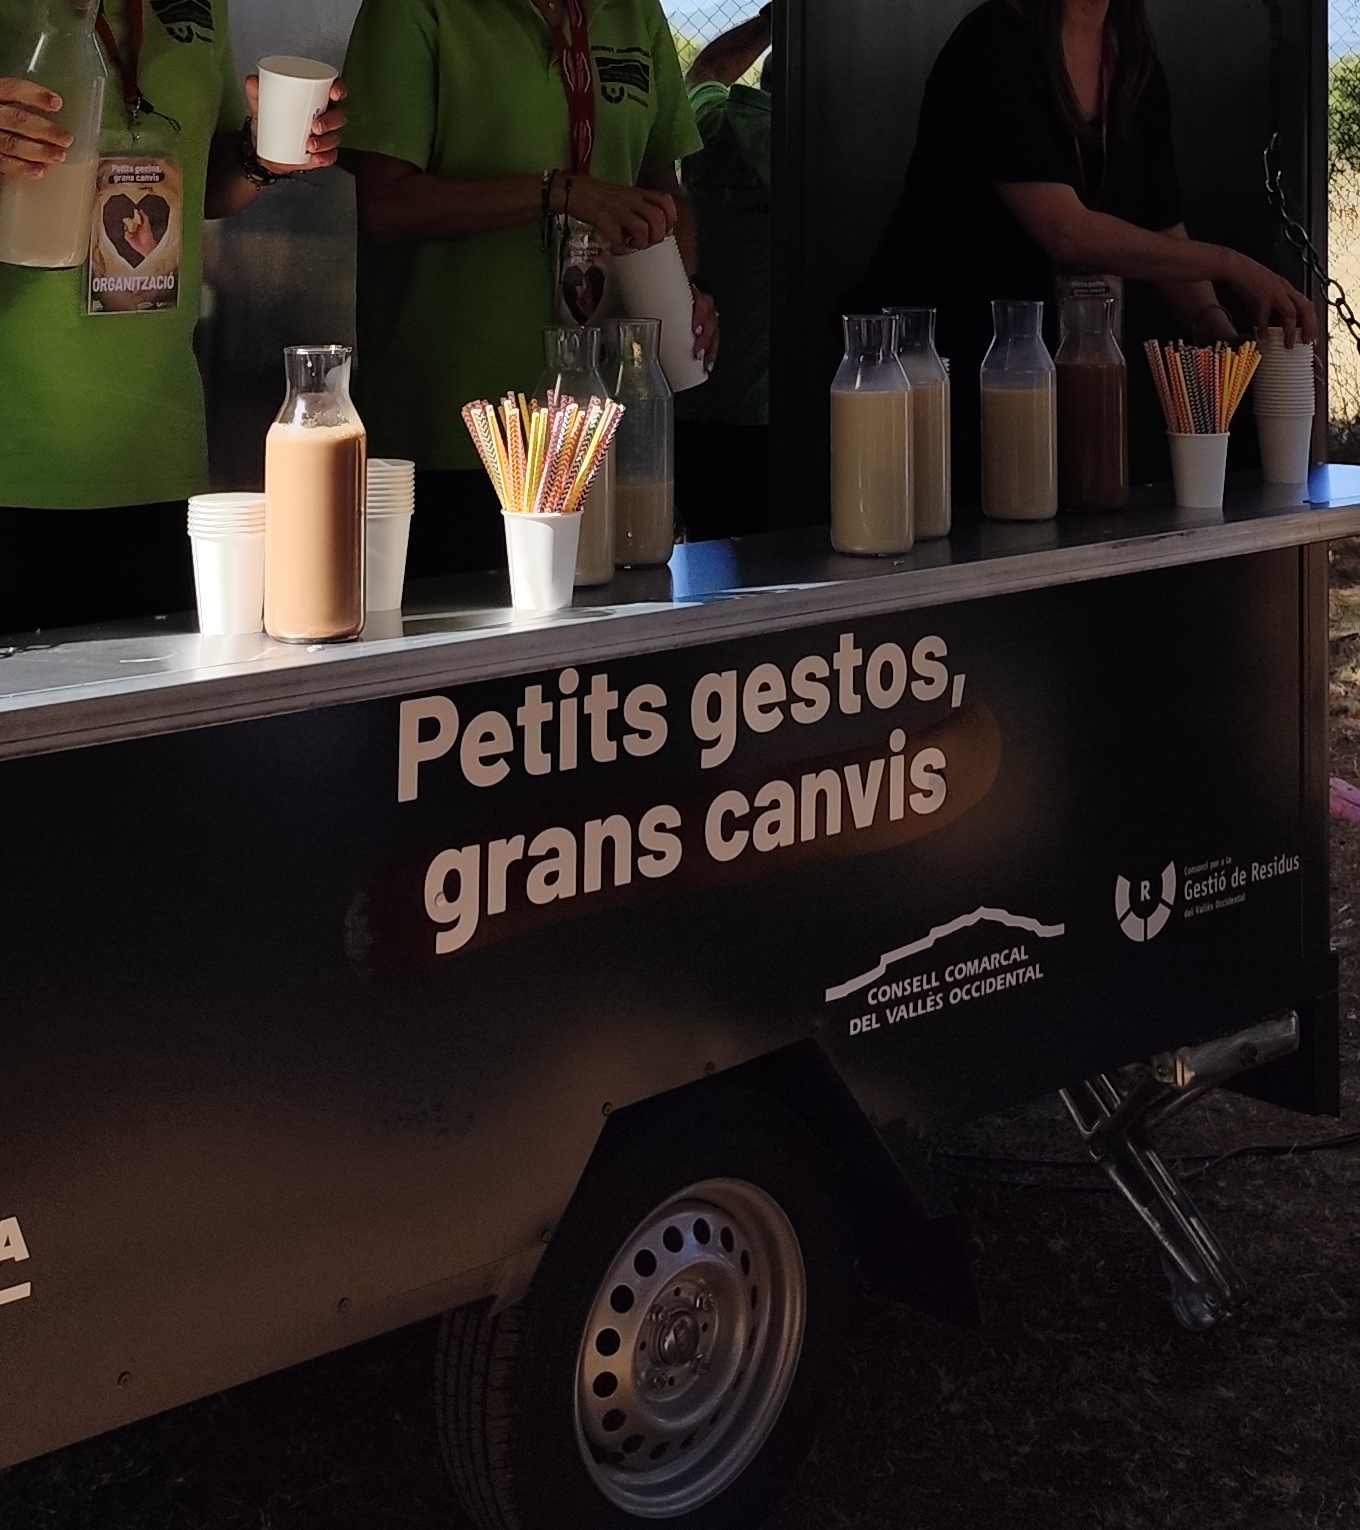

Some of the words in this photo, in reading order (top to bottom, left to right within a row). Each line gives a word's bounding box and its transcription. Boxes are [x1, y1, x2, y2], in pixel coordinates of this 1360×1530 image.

[92, 272, 175, 292] ORGANITZACIÓ
[397, 666, 669, 803] Petits
[690, 632, 967, 770] gestos,
[424, 804, 683, 955] grans
[704, 728, 948, 863] canvis
[1140, 880, 1152, 902] R
[1184, 869, 1227, 901] Gestió
[1231, 866, 1247, 888] de
[1251, 853, 1300, 882] Residus
[849, 1012, 881, 1037] DEL
[885, 990, 944, 1027] VALLÈS
[948, 963, 1045, 1006] OCCIDENTAL
[867, 970, 940, 1006] CONSELL
[944, 944, 1030, 984] COMARCAL
